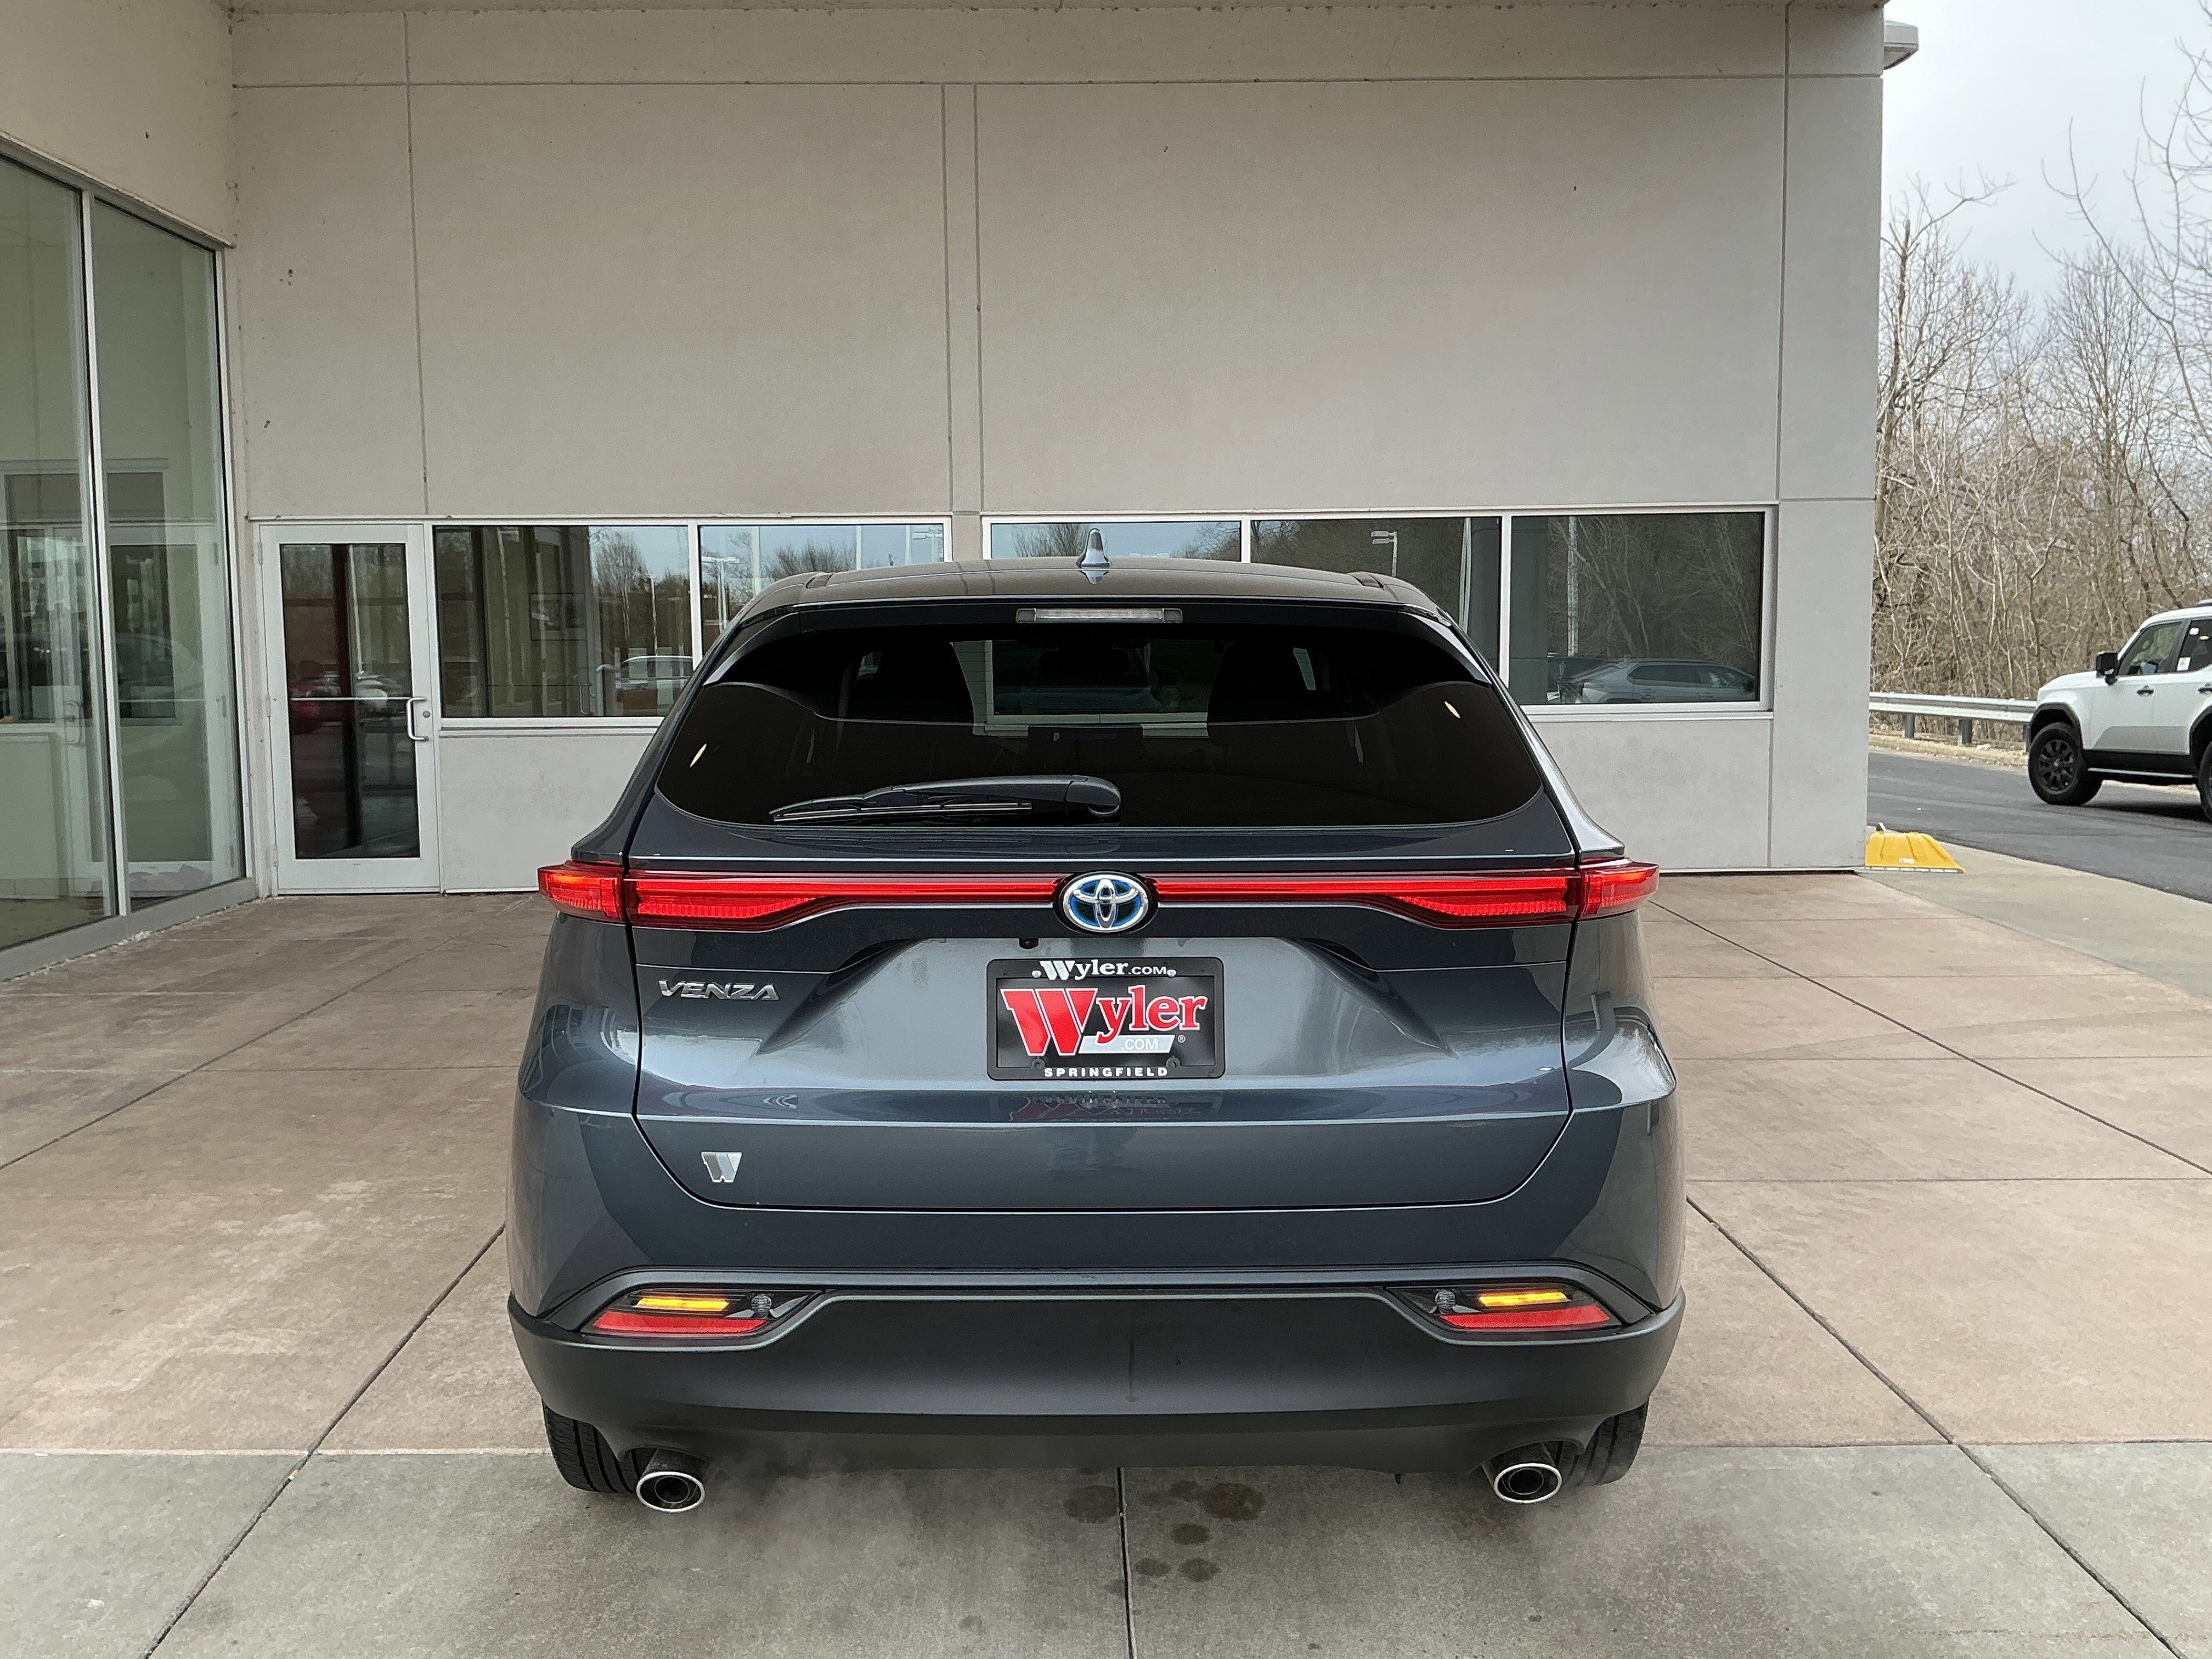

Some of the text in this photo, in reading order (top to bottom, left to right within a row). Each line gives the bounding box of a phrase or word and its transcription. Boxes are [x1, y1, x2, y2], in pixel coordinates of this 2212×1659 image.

[659, 979, 780, 1001] VENZA
[1000, 985, 1208, 1056] Wyler
[1044, 1067, 1168, 1077] SPRINGFIELD
